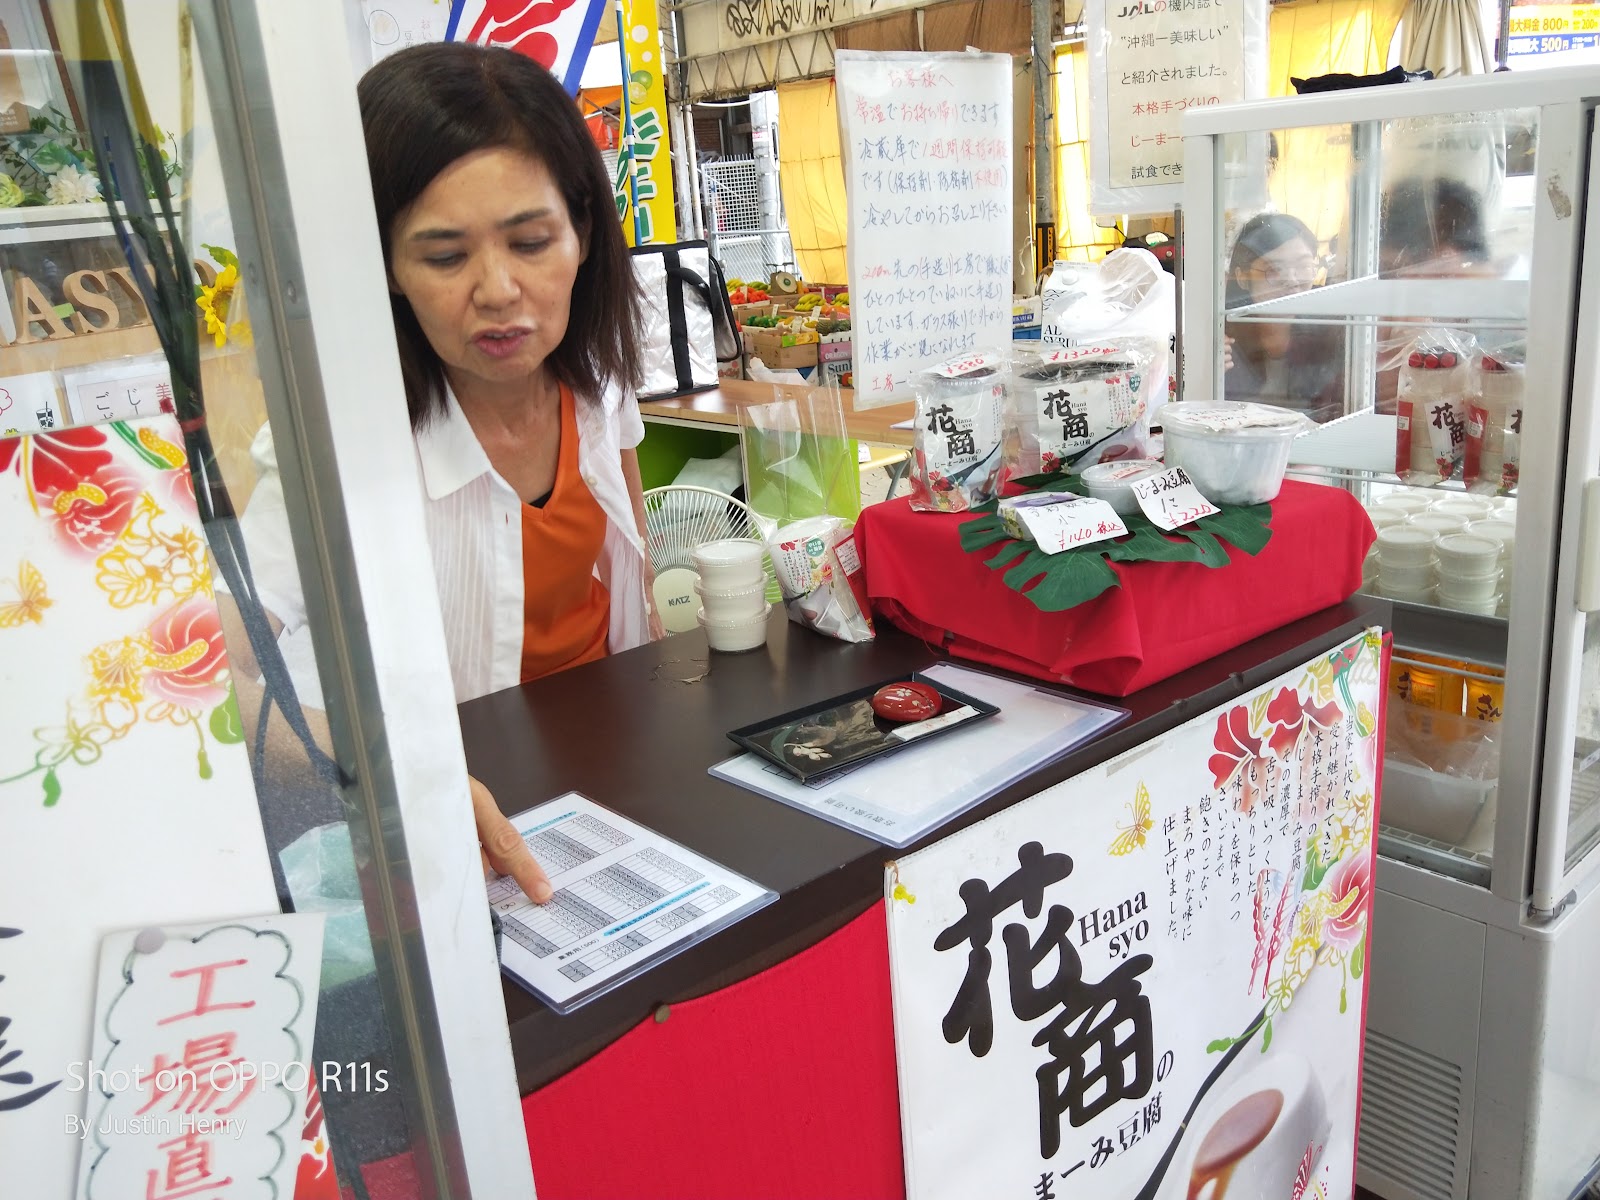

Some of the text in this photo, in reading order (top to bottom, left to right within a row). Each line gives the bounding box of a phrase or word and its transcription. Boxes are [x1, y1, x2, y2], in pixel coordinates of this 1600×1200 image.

[856, 96, 999, 127] 常温でお持ち帰りできます
[888, 67, 954, 88] お客様へ
[1121, 64, 1228, 85] と紹介されました。
[925, 403, 975, 459] 花商
[1043, 389, 1089, 441] 花商
[1279, 748, 1292, 837] その濃厚で
[1321, 721, 1341, 864] 受け継がれてきた
[1343, 714, 1355, 801] 当家に代々
[1182, 805, 1195, 941] まろやかな味に
[1199, 795, 1212, 910] 飽きのこない
[1215, 787, 1228, 878] さいごまで
[1229, 774, 1243, 922] 味わいを保ちつつ
[1247, 766, 1260, 897] もっちりとした
[1078, 891, 1149, 946] Hana
[1163, 816, 1179, 939] 仕上げました。
[1109, 919, 1150, 960] syo
[934, 840, 1174, 1159] 花商 の
